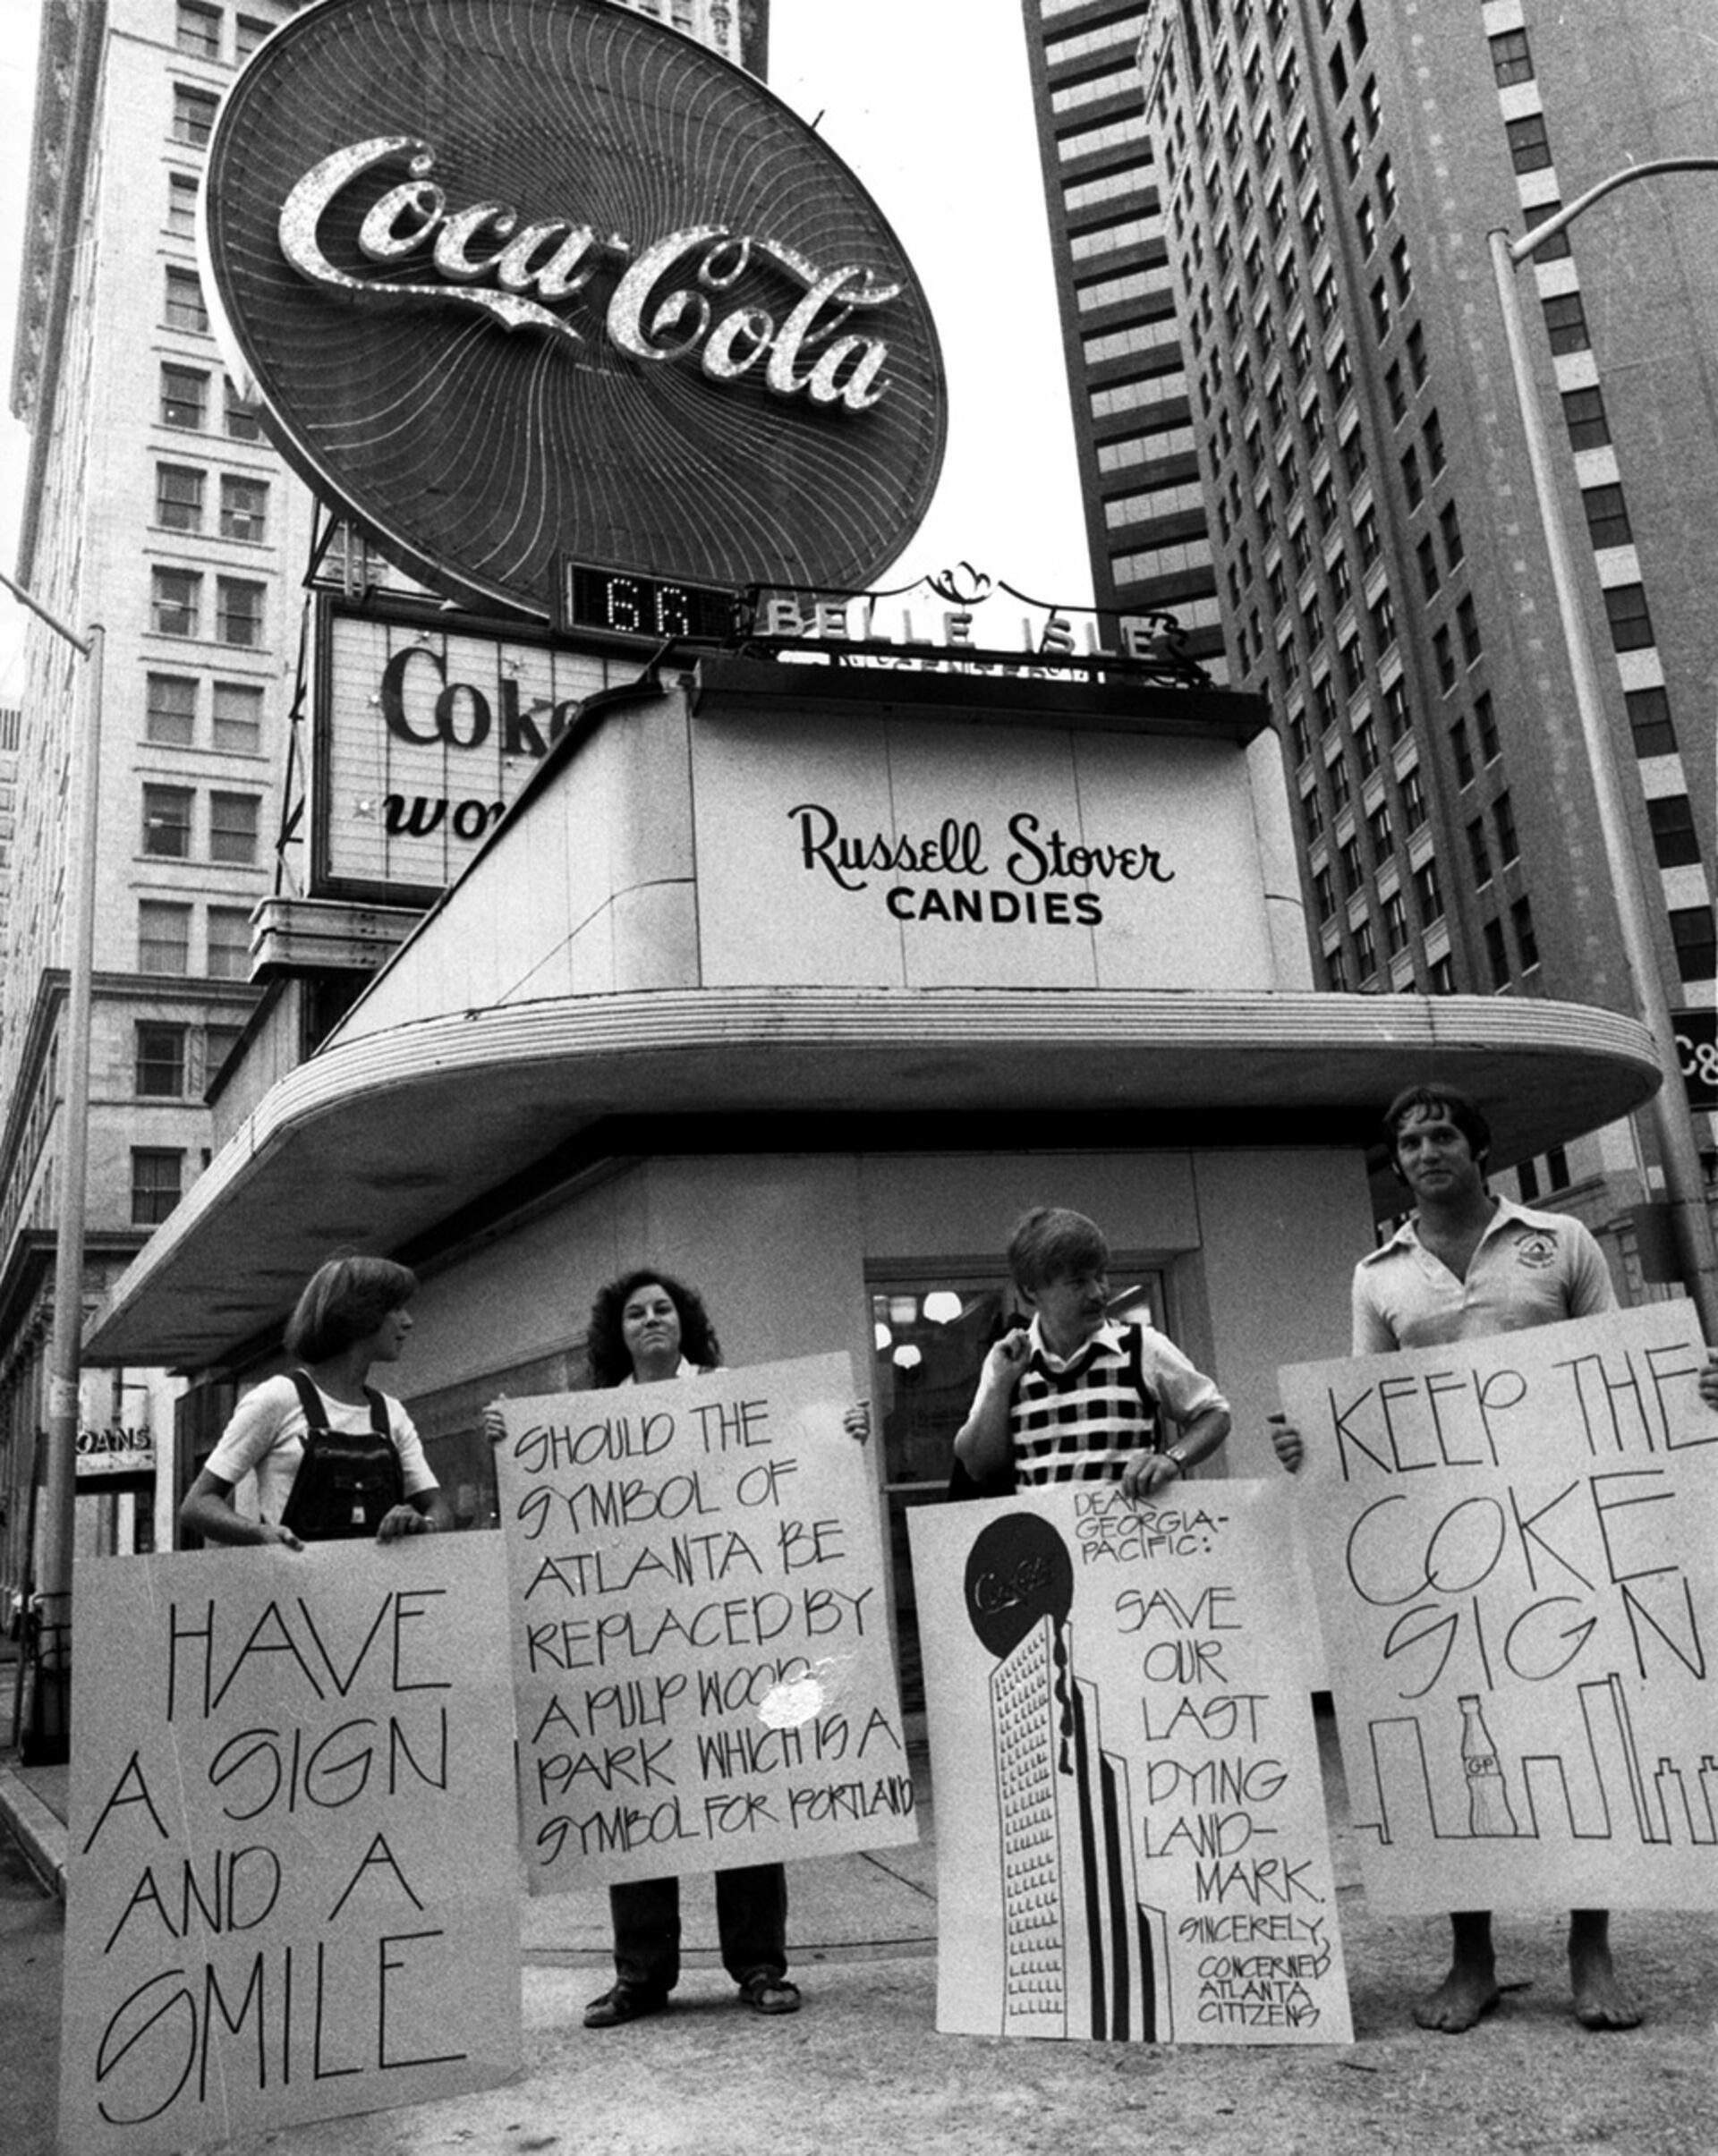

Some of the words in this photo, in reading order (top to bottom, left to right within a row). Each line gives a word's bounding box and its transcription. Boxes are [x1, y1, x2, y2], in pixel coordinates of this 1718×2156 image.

[766, 598, 976, 649] BELLE
[1022, 615, 1158, 659] ISLE
[787, 803, 989, 891] Russell
[1007, 812, 1176, 886] Stover
[886, 886, 1103, 926] CANDIES
[75, 1424, 151, 1455] OANS
[514, 1412, 675, 1473] SHOULD
[689, 1400, 772, 1453] THE
[1328, 1369, 1527, 1481] KEEP
[1551, 1343, 1717, 1456] THE
[516, 1470, 720, 1539] SYMBOL
[736, 1458, 797, 1507] OF
[523, 1531, 763, 1600] ATLANTA
[778, 1519, 846, 1575] BE
[1082, 1534, 1211, 1565] PACIFIC:
[1346, 1469, 1680, 1607] COKE
[527, 1592, 792, 1673] REPLACED
[804, 1586, 873, 1637] BY
[1116, 1586, 1243, 1634] SAVE
[1383, 1576, 1706, 1700] SIGN
[166, 1589, 452, 1722] HAVE
[1144, 1640, 1229, 1684] OUR
[532, 1694, 580, 1744] A
[585, 1673, 687, 1736] PULP
[1142, 1694, 1270, 1744] LAST
[82, 1750, 169, 1854] A
[208, 1707, 447, 1821] SIGN
[538, 1737, 676, 1805] PARK
[697, 1727, 803, 1780] WHICH
[815, 1713, 849, 1761] IS
[857, 1707, 901, 1758] A
[1147, 1758, 1288, 1806] DYING
[1468, 1755, 1494, 1776] GP
[537, 1795, 700, 1865] SYMBOL
[704, 1791, 779, 1840] FOR
[787, 1776, 914, 1829] PORTLAND
[1144, 1811, 1277, 1860] LAND-
[104, 1846, 282, 1954] AND
[328, 1832, 424, 1921] A
[1195, 1856, 1325, 1906] MARK.
[1198, 1954, 1331, 1980] CONCERNED
[1198, 1980, 1314, 2007] ATLANTA
[96, 1931, 467, 2126] SMILE
[1198, 2000, 1321, 2028] CITIZENS
